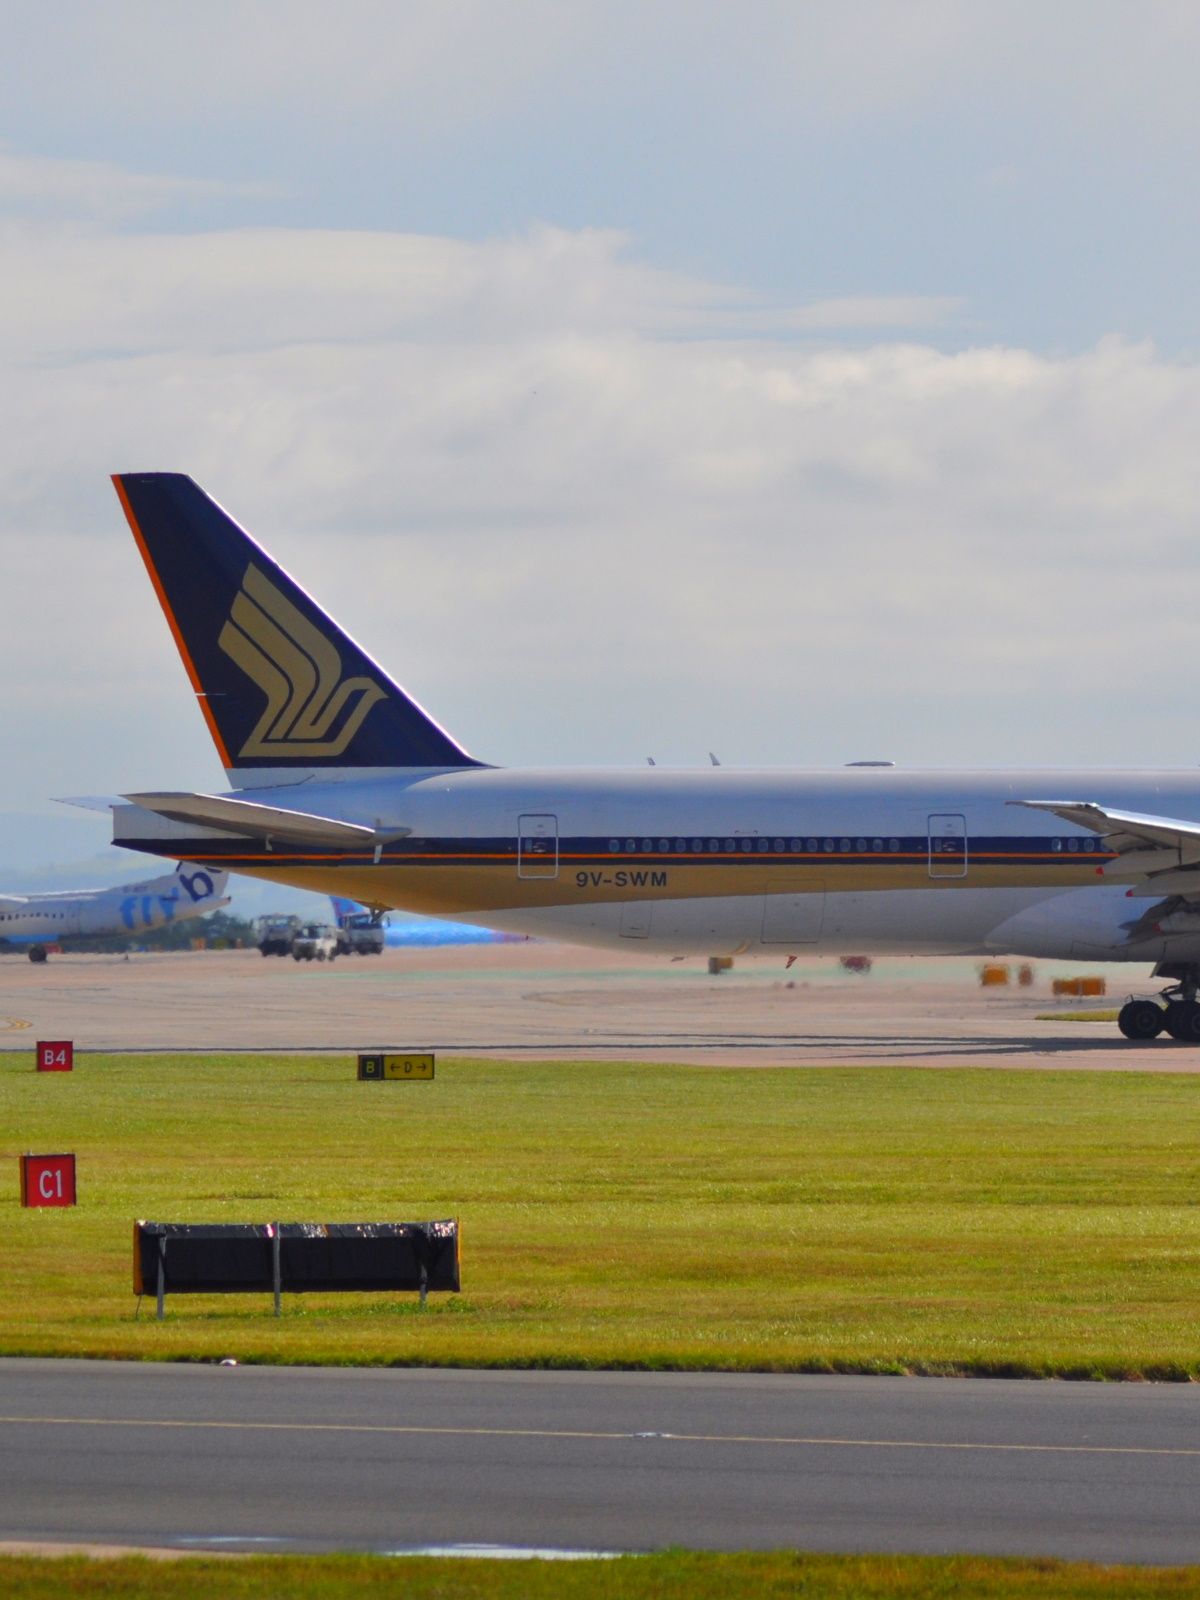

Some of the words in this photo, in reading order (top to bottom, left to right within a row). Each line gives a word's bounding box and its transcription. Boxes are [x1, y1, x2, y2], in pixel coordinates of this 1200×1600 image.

[576, 872, 667, 887] 9V-SWM
[44, 1050, 66, 1065] B4
[366, 1061, 375, 1073] B
[404, 1061, 412, 1073] D
[39, 1169, 62, 1198] C1
